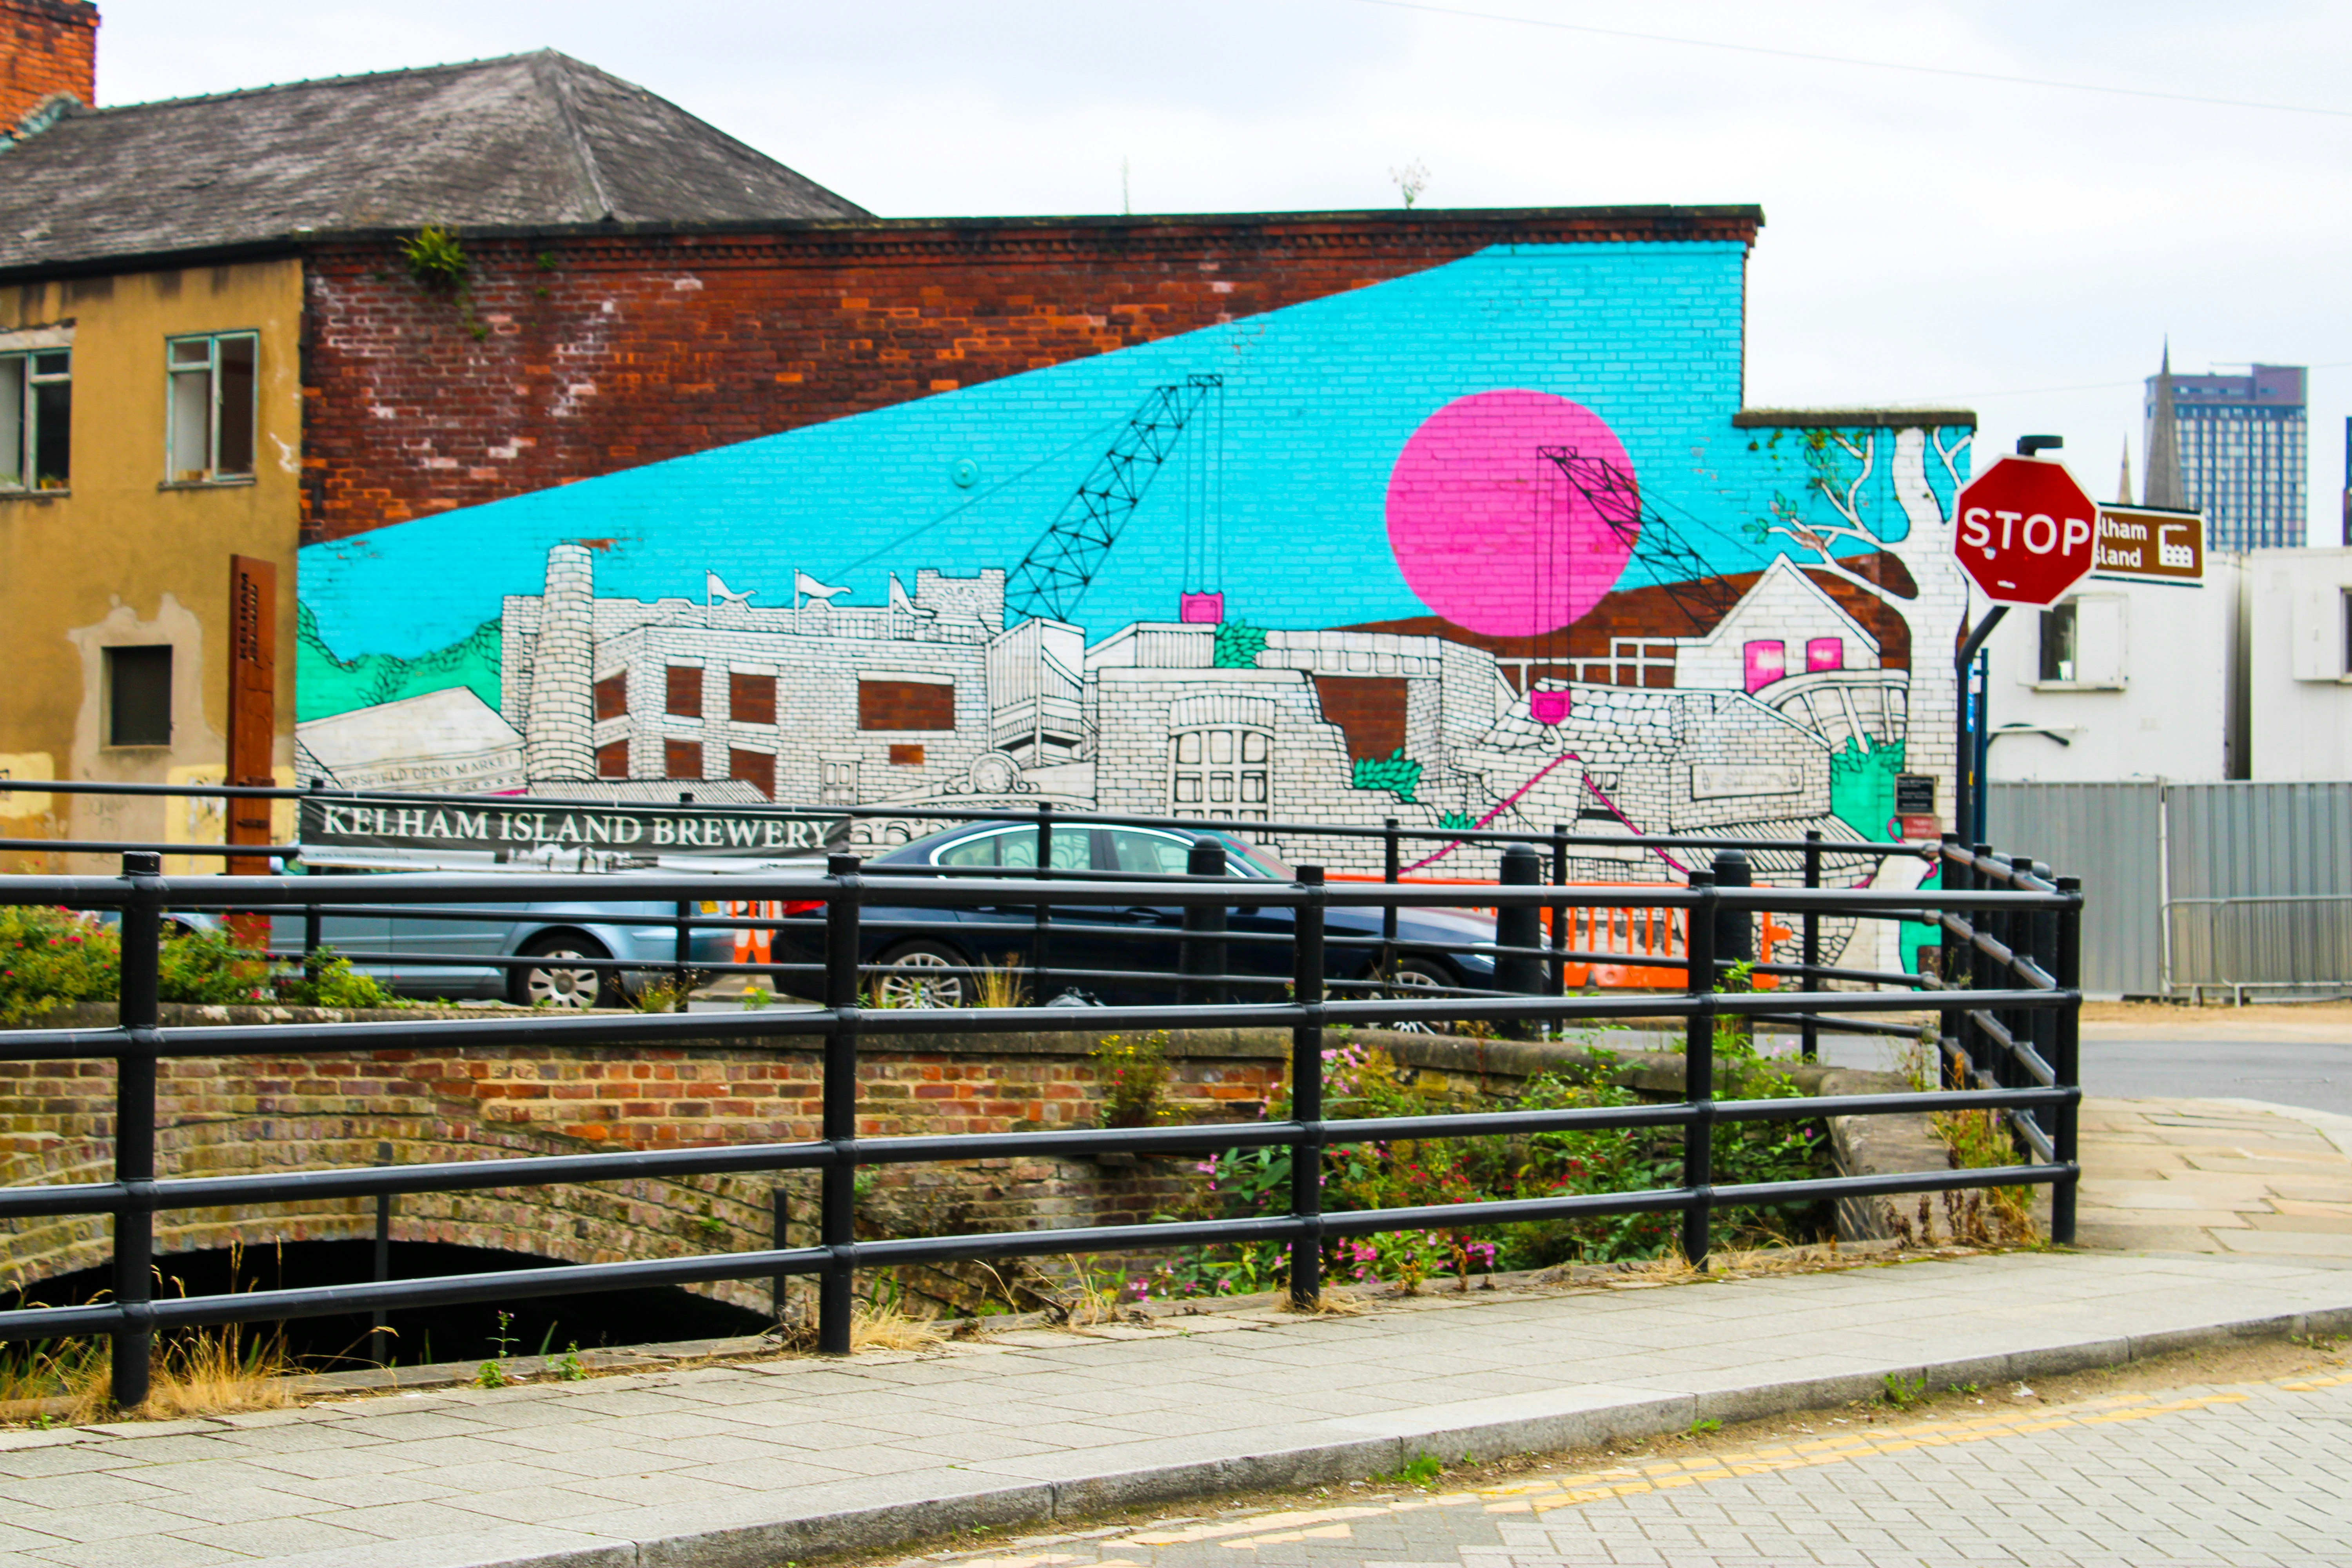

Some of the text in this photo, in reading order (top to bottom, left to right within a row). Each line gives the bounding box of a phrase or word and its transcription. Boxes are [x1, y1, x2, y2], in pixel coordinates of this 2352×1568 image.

[1961, 507, 2090, 557] STOP
[2099, 517, 2147, 541] lham
[413, 764, 450, 779] OPEN
[456, 753, 513, 775] MARKET
[322, 805, 835, 849] KELHAM ISLAND BREWERY
